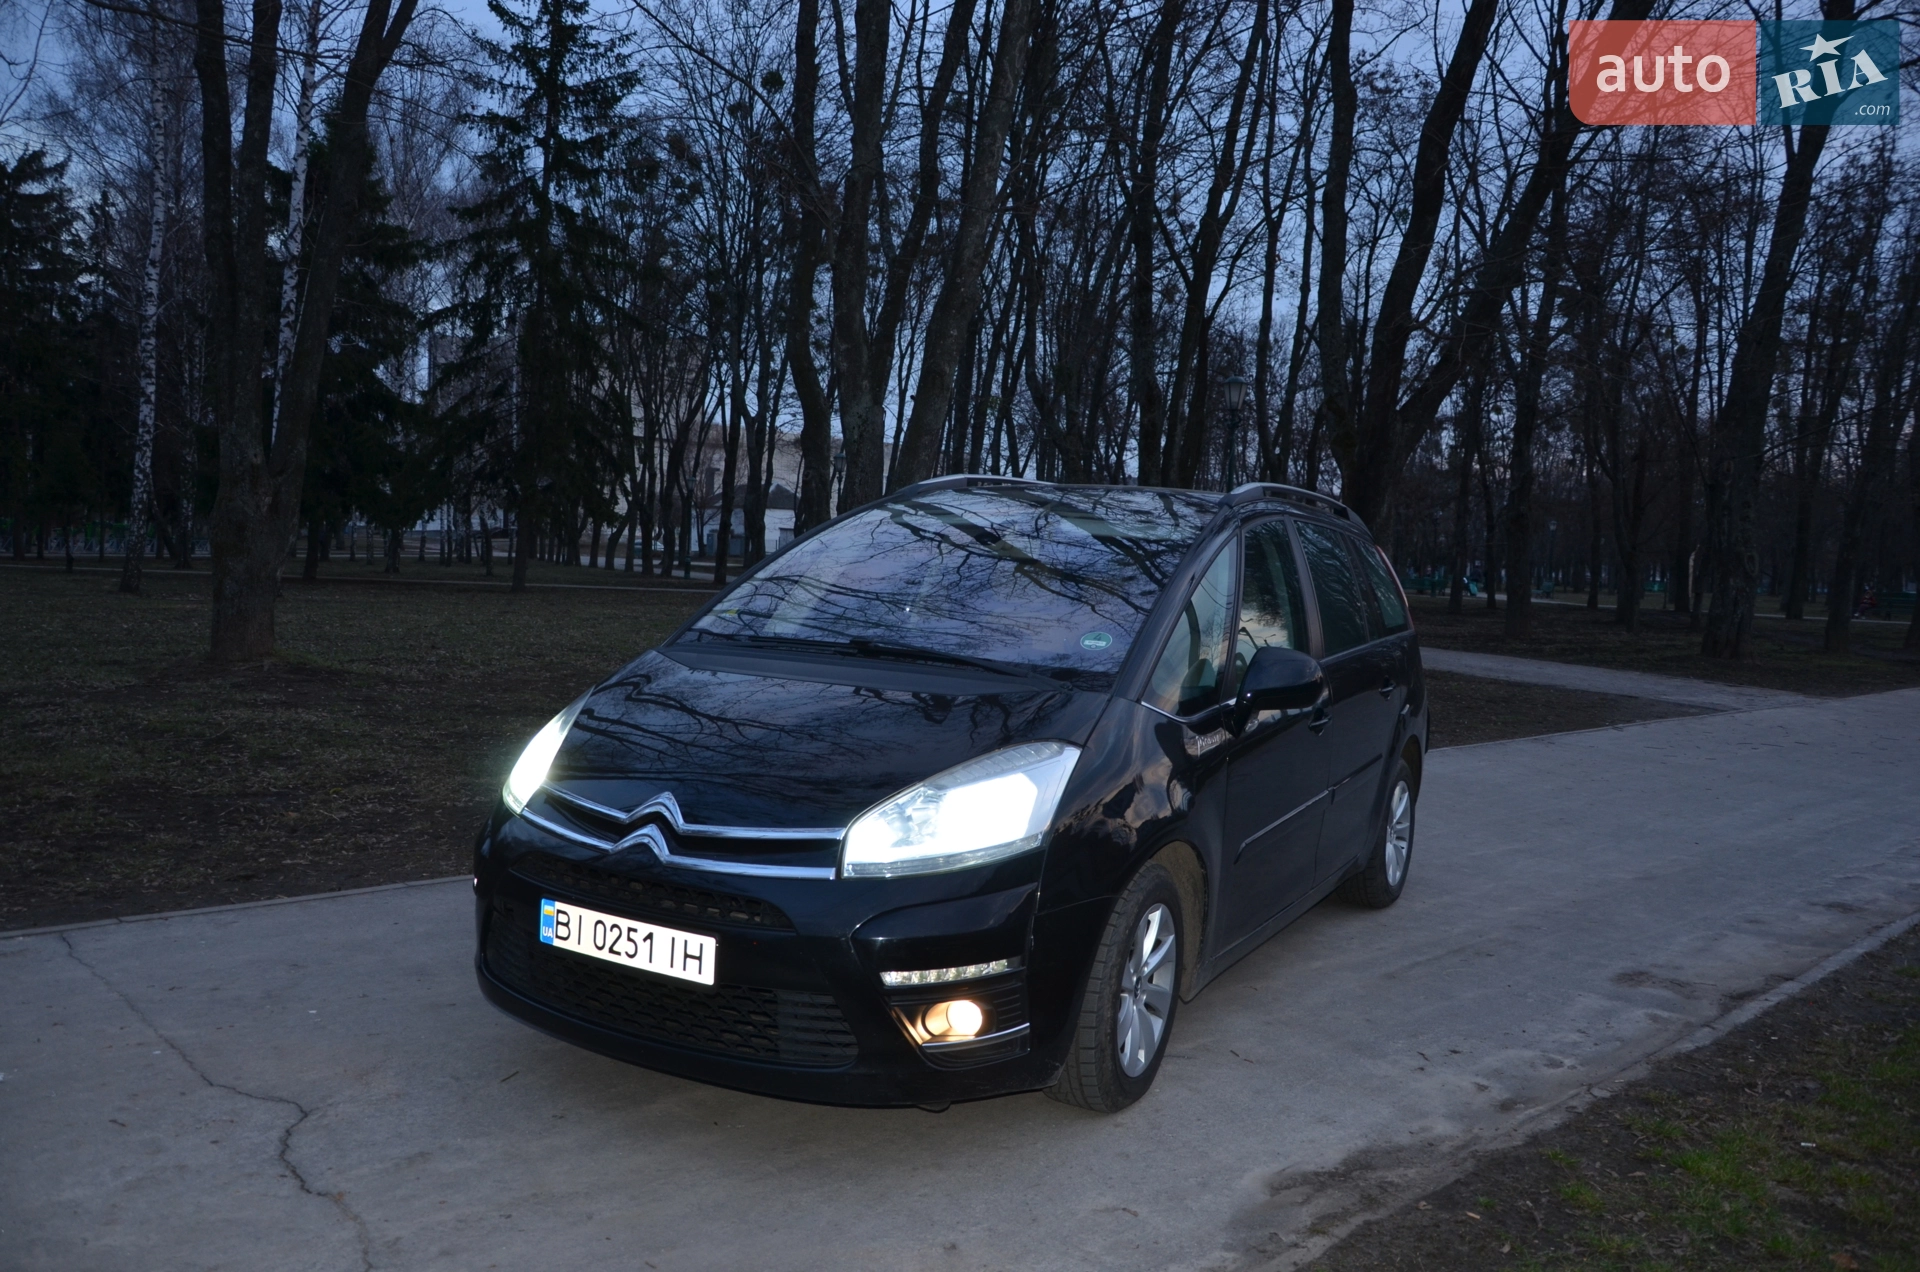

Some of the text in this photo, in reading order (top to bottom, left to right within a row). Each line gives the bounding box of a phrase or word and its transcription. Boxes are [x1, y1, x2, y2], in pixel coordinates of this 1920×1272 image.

[542, 925, 554, 939] UA
[555, 908, 704, 975] BI 0251 IH
